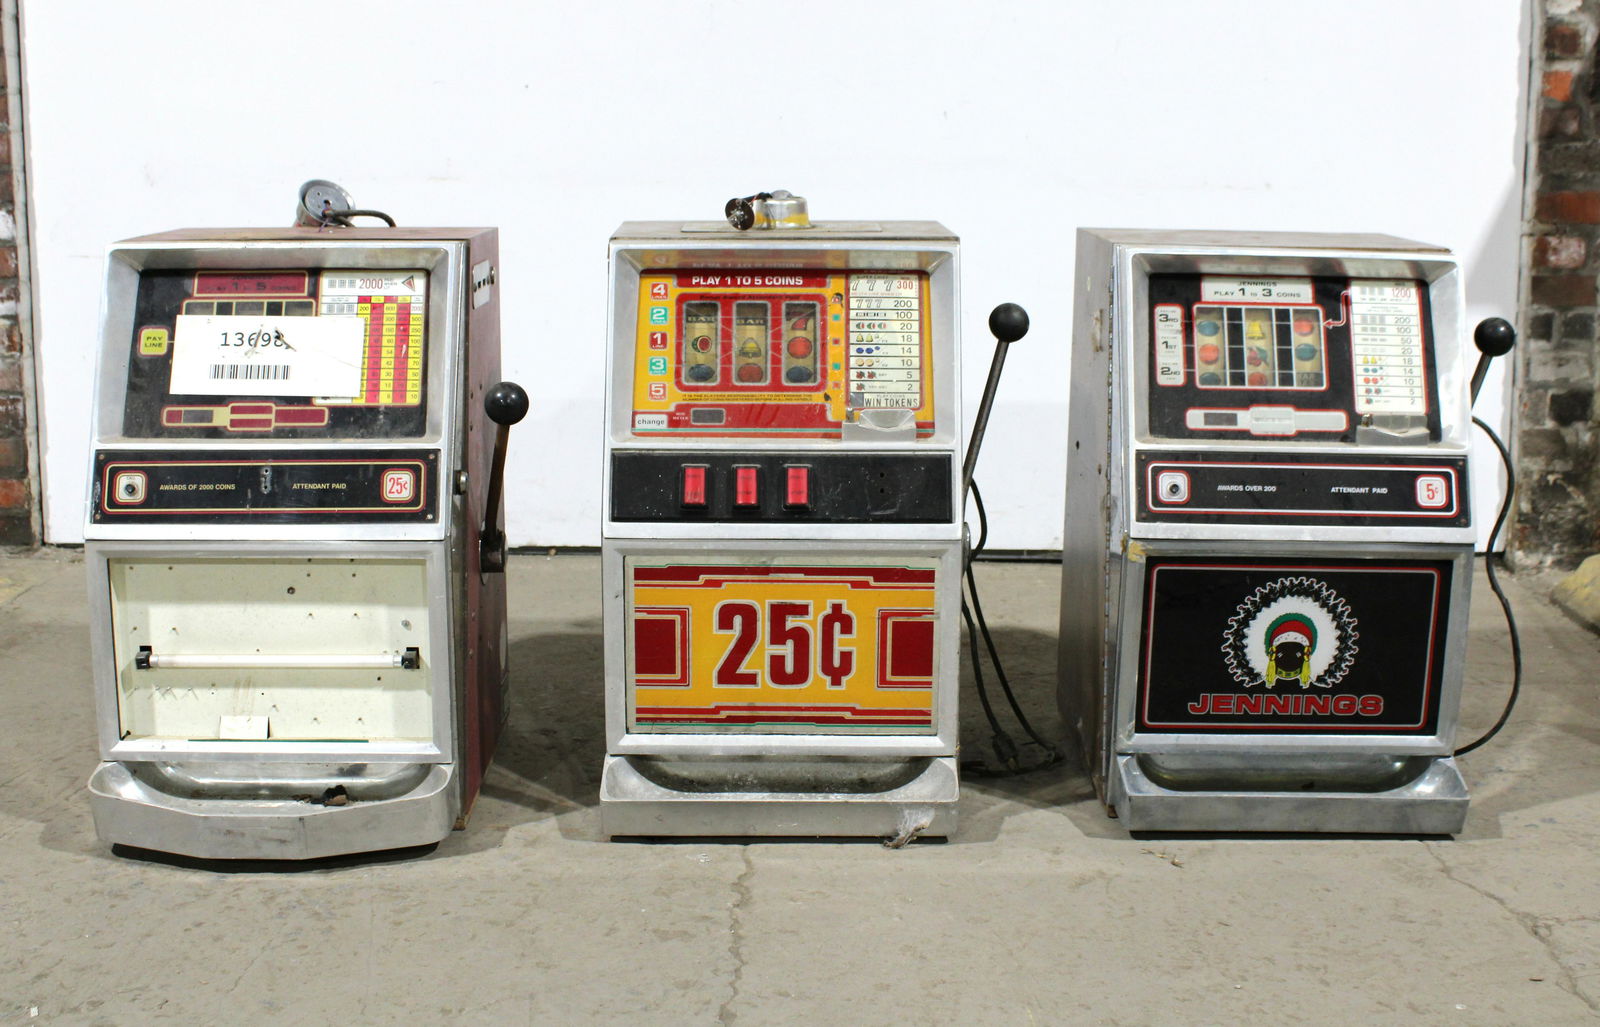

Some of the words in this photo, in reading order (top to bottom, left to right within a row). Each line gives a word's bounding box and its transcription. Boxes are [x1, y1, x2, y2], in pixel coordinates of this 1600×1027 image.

[359, 278, 384, 289] 2000
[692, 276, 720, 286] PLAY
[725, 276, 731, 286] 1
[736, 276, 751, 286] TO
[754, 276, 762, 286] 5
[765, 276, 804, 286] COINS
[896, 280, 914, 290] 300
[652, 284, 666, 296] 4
[1238, 288, 1246, 296] 1
[1262, 288, 1272, 297] 3
[1392, 288, 1411, 298] 1200
[894, 300, 912, 308] 200
[652, 308, 666, 320] 2
[653, 332, 662, 344] 1
[651, 358, 664, 370] 3
[651, 384, 664, 396] 5
[864, 398, 881, 408] WIN
[885, 398, 918, 408] TOKENS
[712, 600, 856, 690] 25¢
[1188, 693, 1384, 716] JENNINGS
